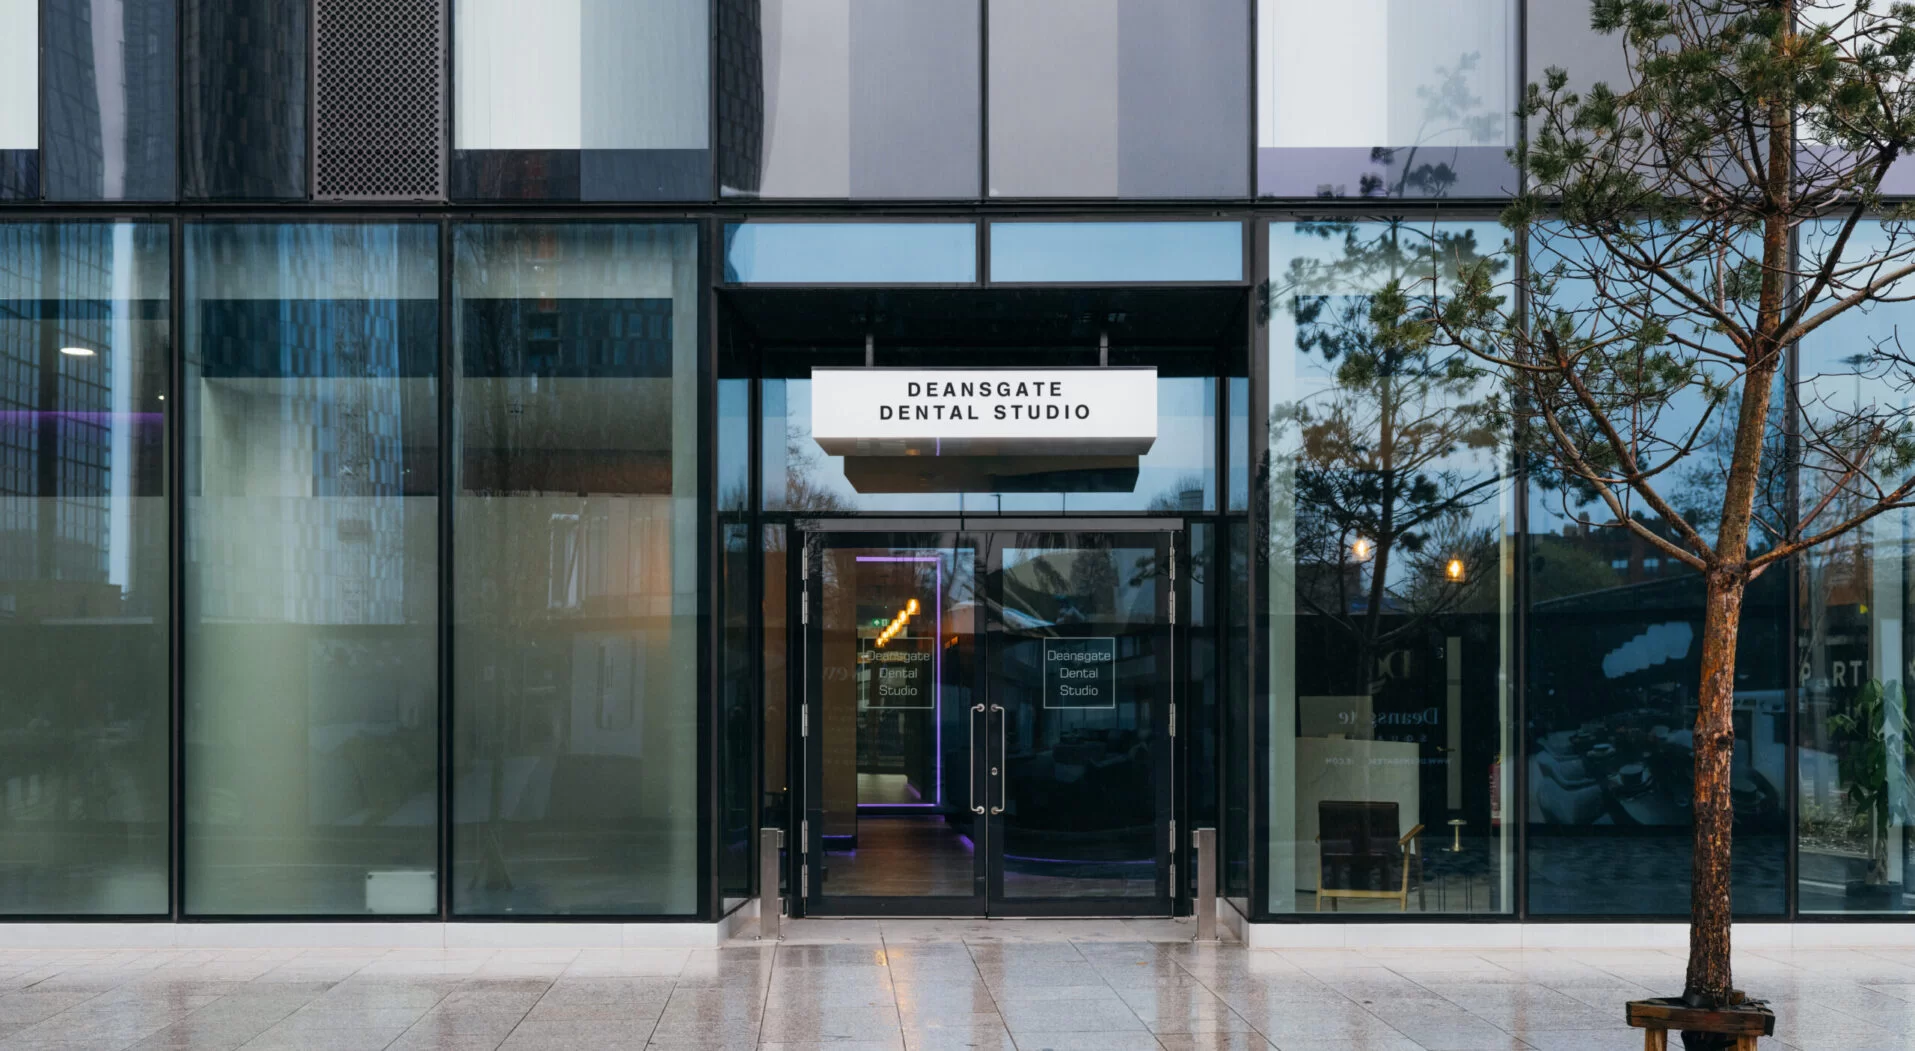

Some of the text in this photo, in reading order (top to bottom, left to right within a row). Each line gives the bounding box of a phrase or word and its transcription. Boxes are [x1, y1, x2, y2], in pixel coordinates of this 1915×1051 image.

[908, 381, 1063, 397] DEANSGATE
[880, 404, 1091, 420] DENTAL STUDIO
[867, 650, 930, 663] Deansgate
[1047, 650, 1111, 663] Deansgate
[879, 667, 918, 679] Dental
[1060, 667, 1099, 679] Dental
[879, 684, 918, 697] Studio
[1060, 684, 1099, 697] Studio
